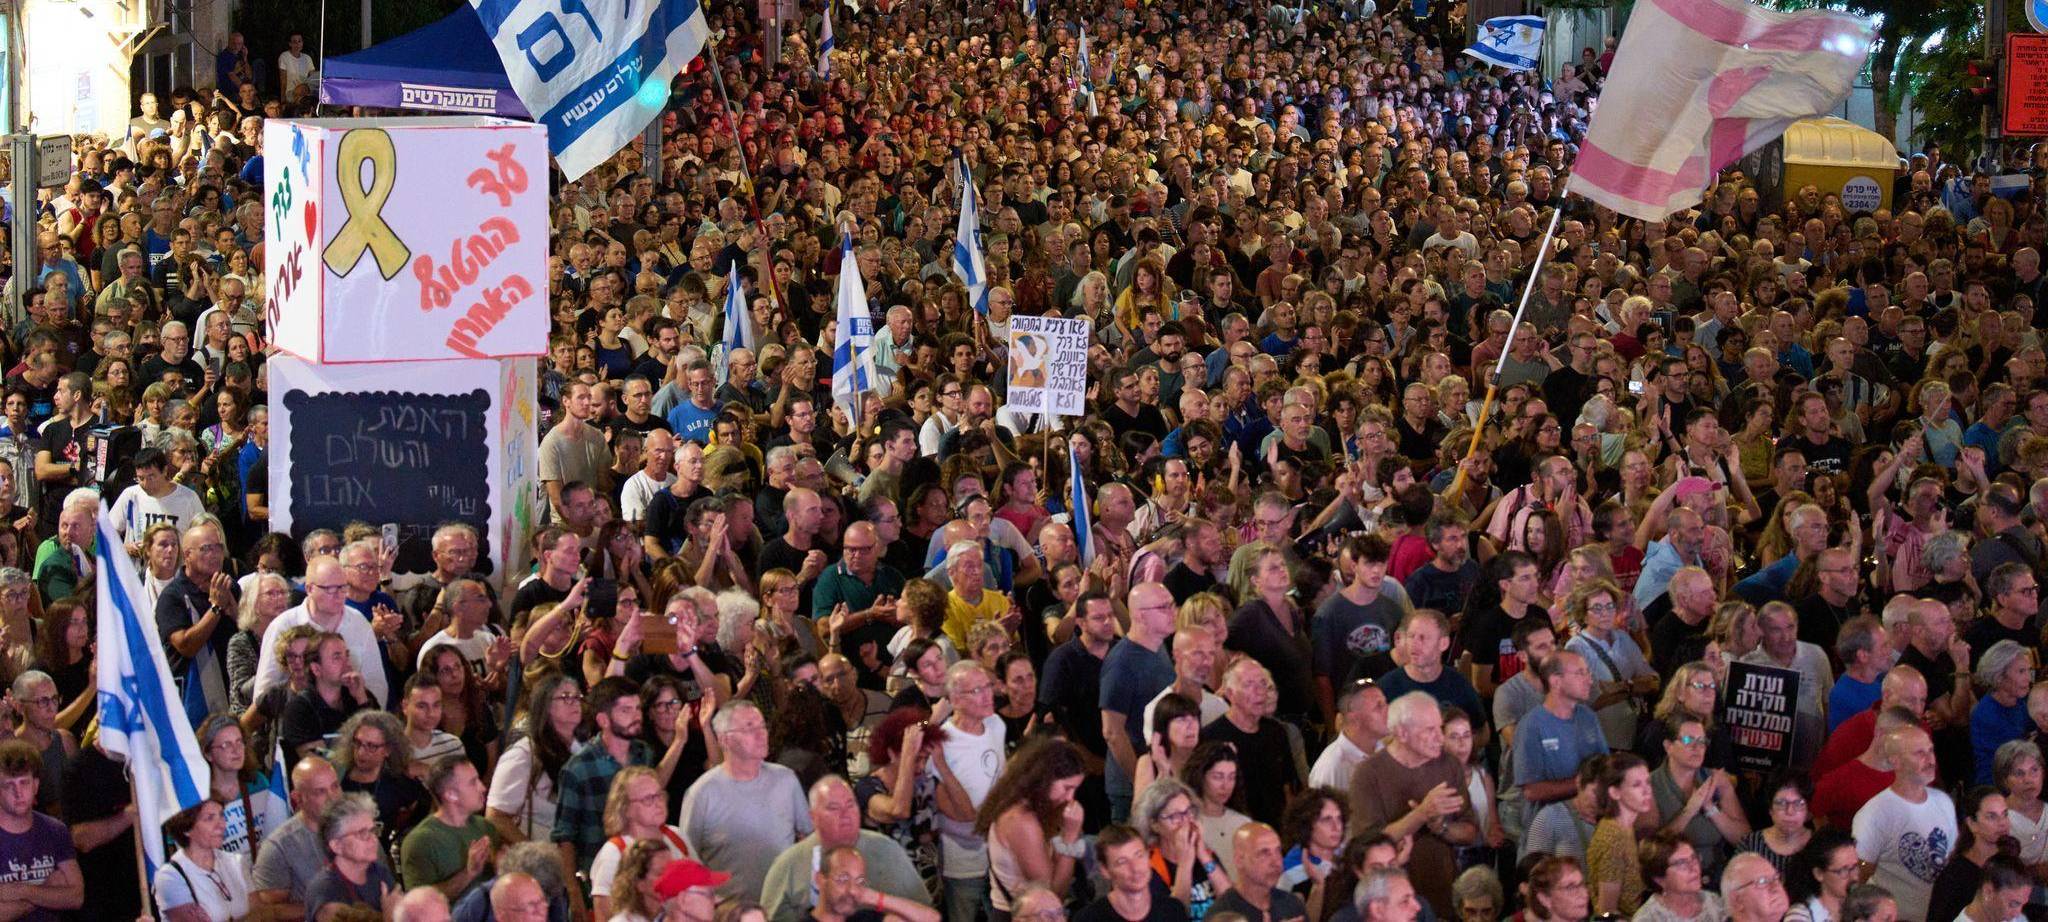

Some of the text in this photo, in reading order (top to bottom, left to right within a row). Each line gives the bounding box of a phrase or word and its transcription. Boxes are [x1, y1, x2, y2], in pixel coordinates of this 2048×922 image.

[402, 88, 496, 108] הדמוקרטים
[561, 54, 644, 128] שלום עכשיו
[467, 143, 529, 207] עד
[1846, 185, 1865, 194] פרש
[413, 215, 520, 313] החטוף
[446, 274, 534, 359] האחרון
[1069, 320, 1085, 335] שאו
[1056, 336, 1088, 354] לא דרך
[1051, 362, 1065, 377] שיר
[1049, 376, 1084, 392] לאהבה
[1056, 392, 1076, 408] ולא
[367, 405, 467, 440] האמת
[326, 419, 430, 469] והשלום
[304, 474, 377, 508] אהבו
[1744, 673, 1784, 695] ועדת
[1736, 688, 1786, 713] חקירה
[1726, 706, 1791, 733] ממלכתית
